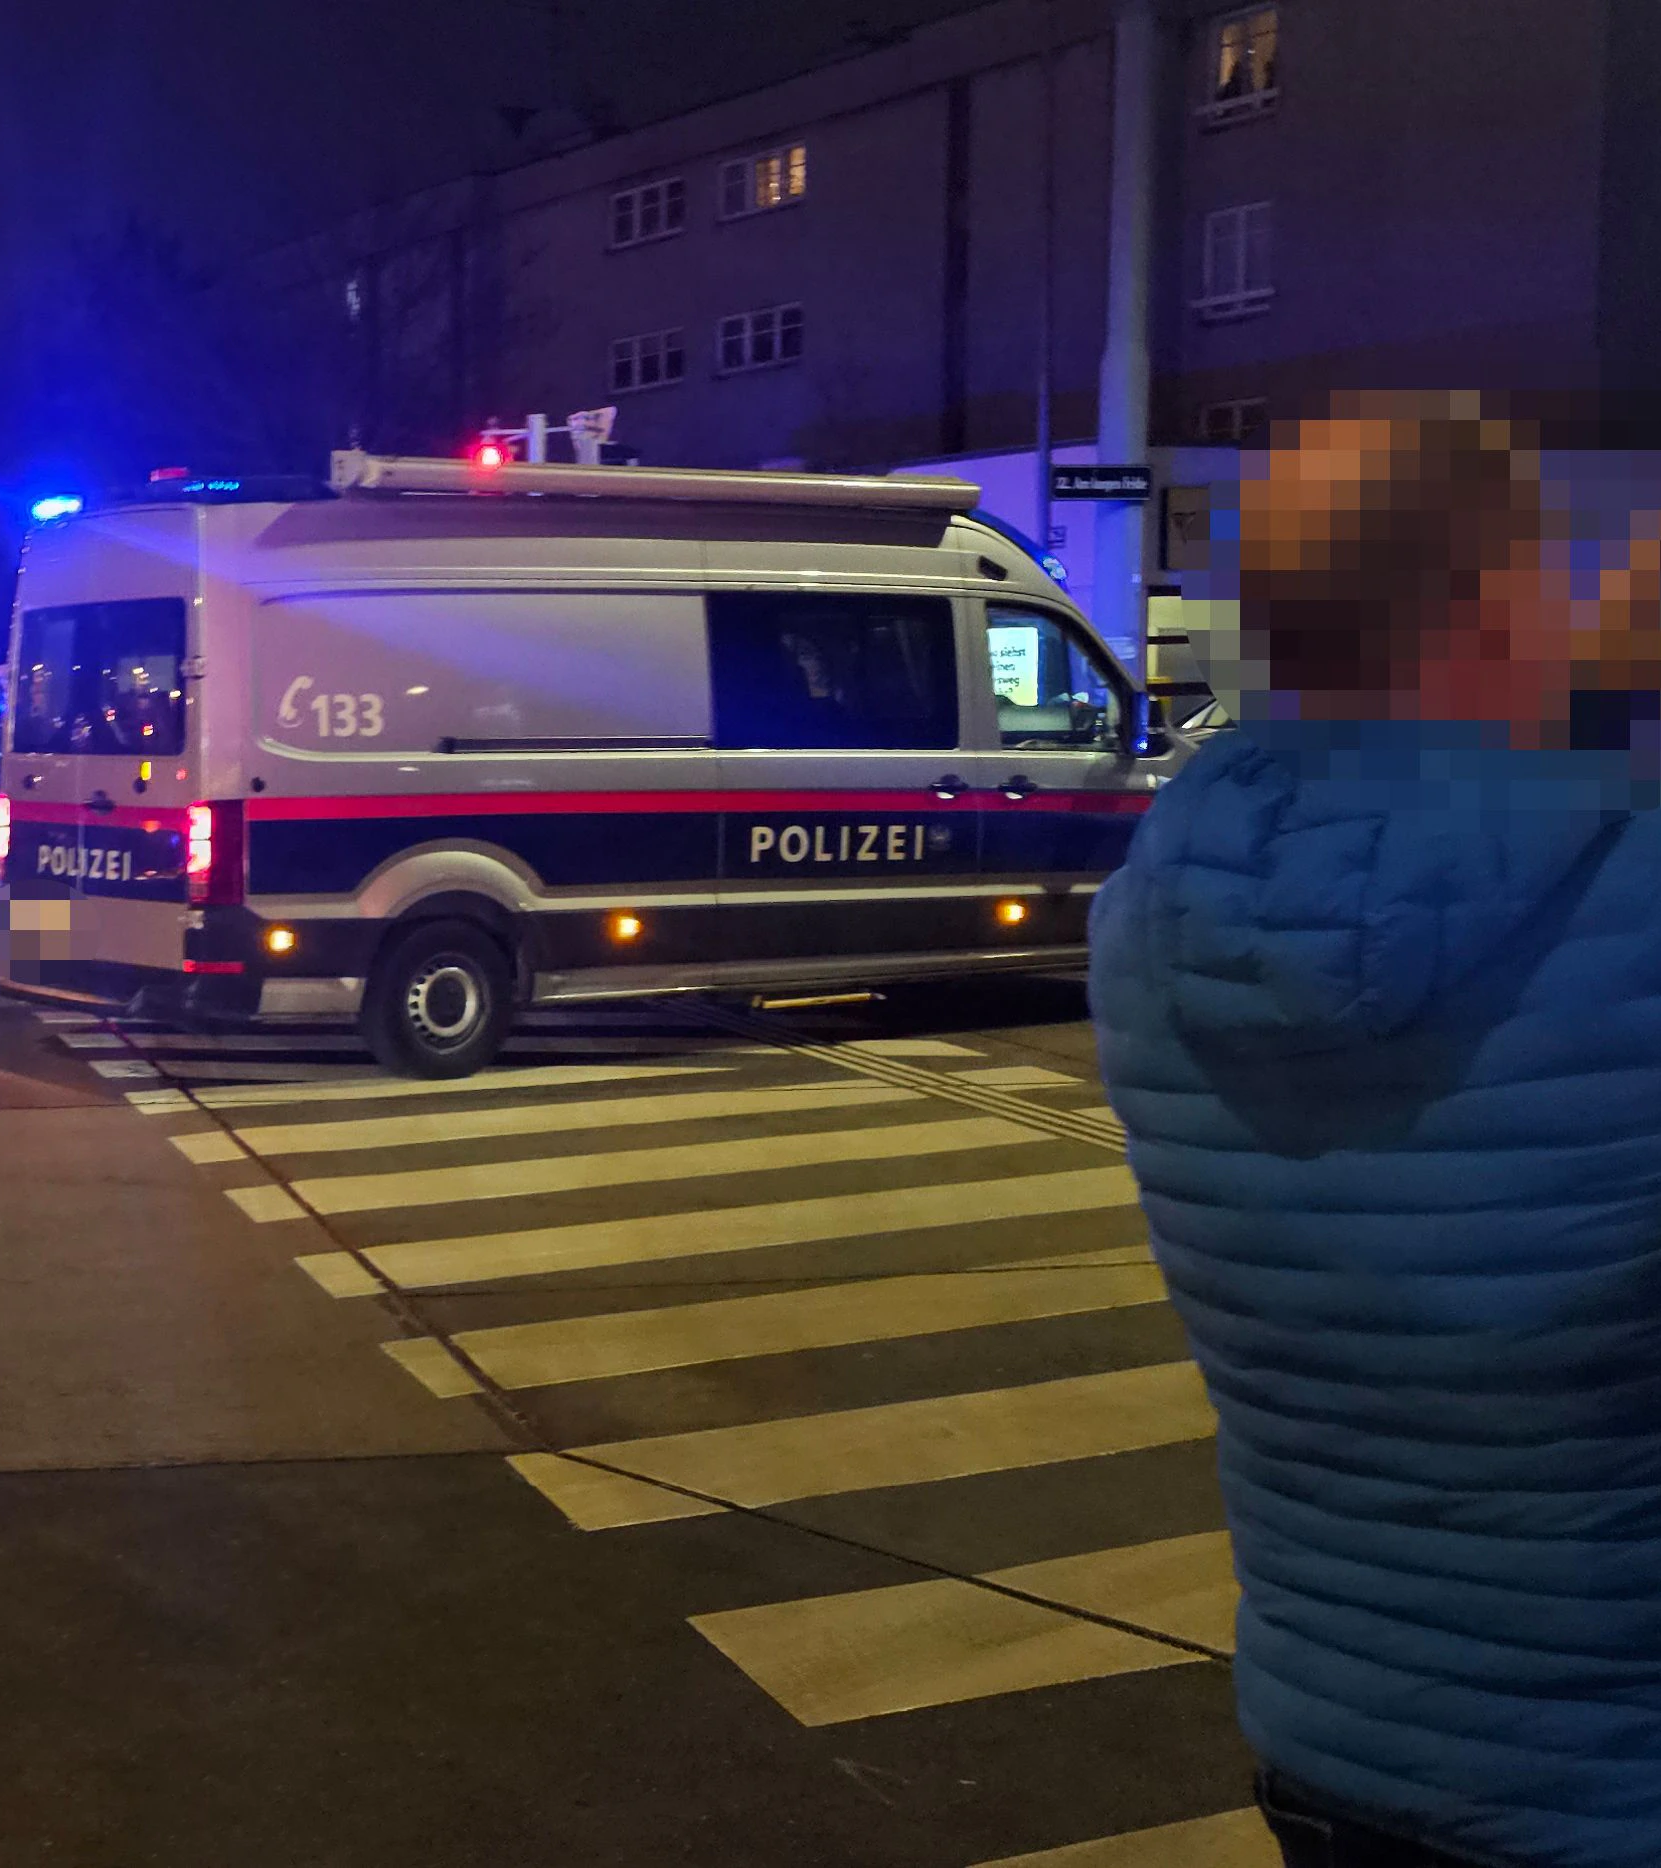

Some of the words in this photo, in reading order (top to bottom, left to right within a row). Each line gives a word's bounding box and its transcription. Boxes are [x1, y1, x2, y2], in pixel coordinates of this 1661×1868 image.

[311, 693, 384, 737] 133
[37, 844, 132, 881] POLIZEI
[749, 824, 925, 863] POLIZEI
